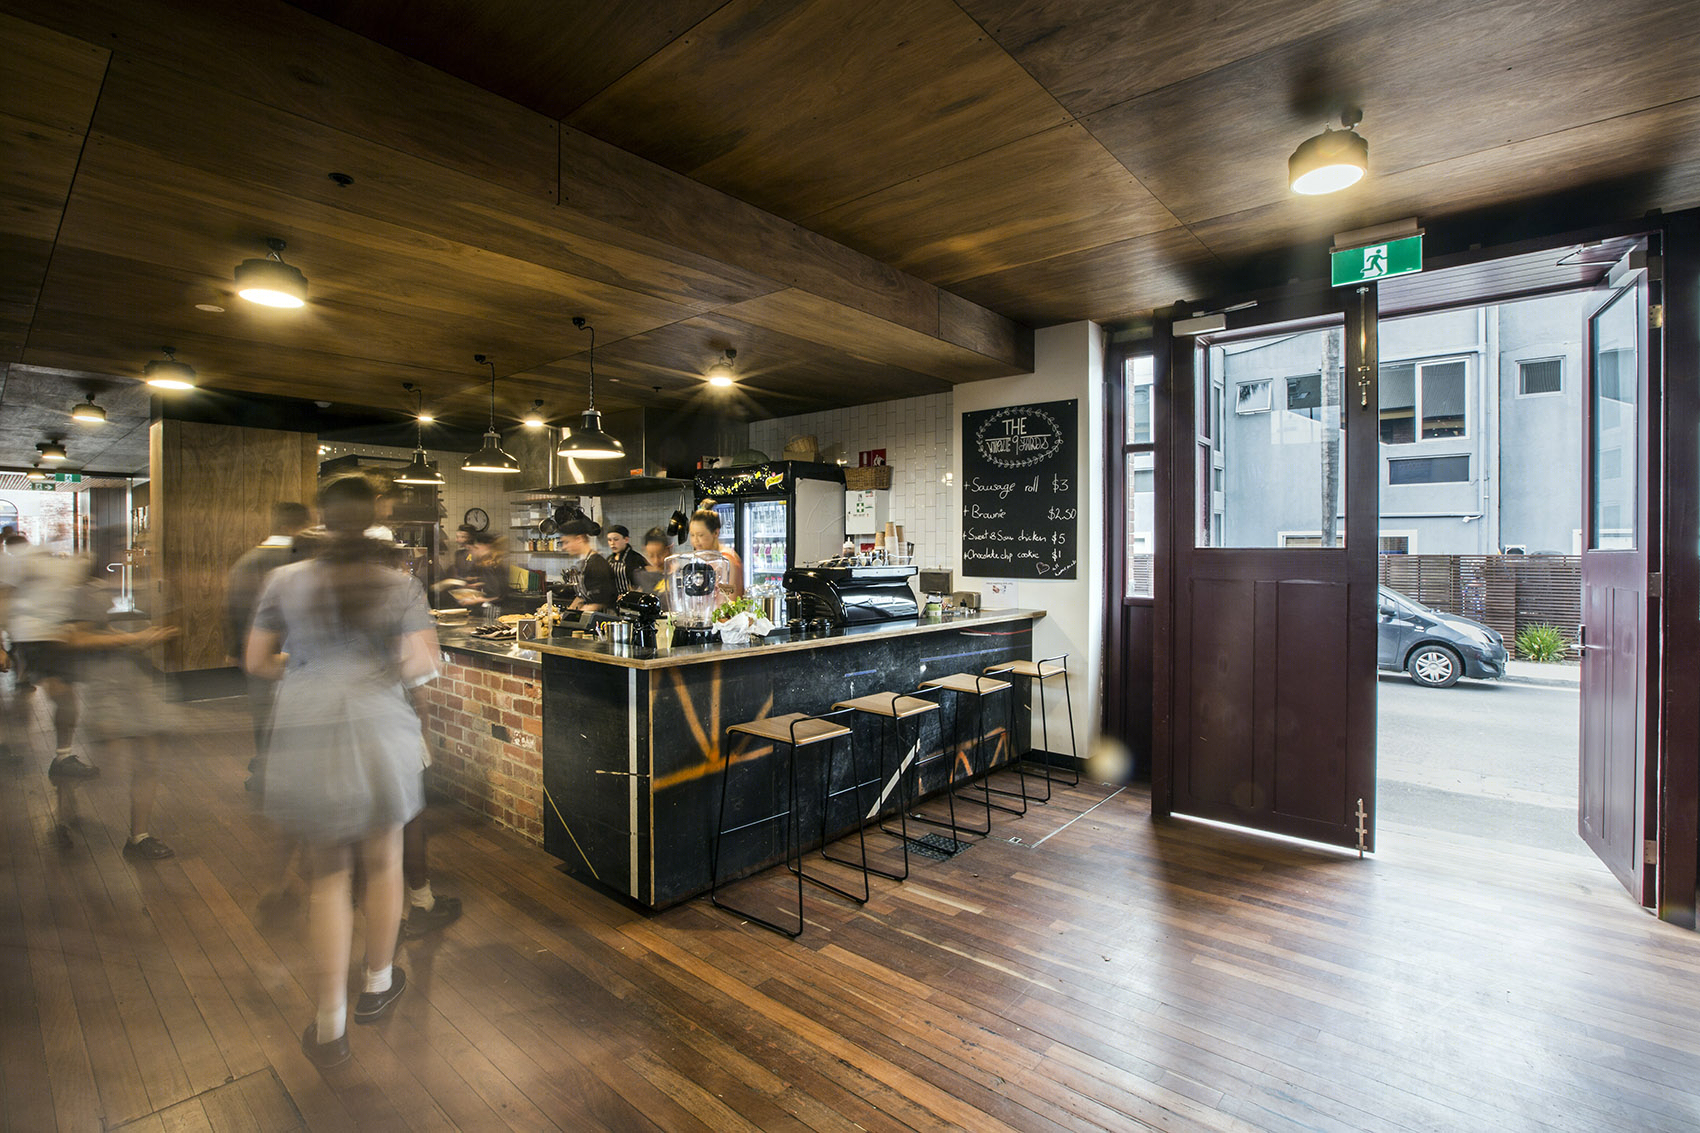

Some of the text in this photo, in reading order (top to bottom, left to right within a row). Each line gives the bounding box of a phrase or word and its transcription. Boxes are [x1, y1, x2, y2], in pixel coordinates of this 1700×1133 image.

[1002, 417, 1027, 435] THE
[1012, 435, 1019, 455] 9
[971, 473, 1069, 499] Sausage roll $3
[971, 504, 1077, 520] Brownie $2.50
[1018, 530, 1046, 542] chicken
[1052, 531, 1066, 544] $5
[1017, 550, 1039, 558] cookie
[1052, 548, 1061, 561] $1
